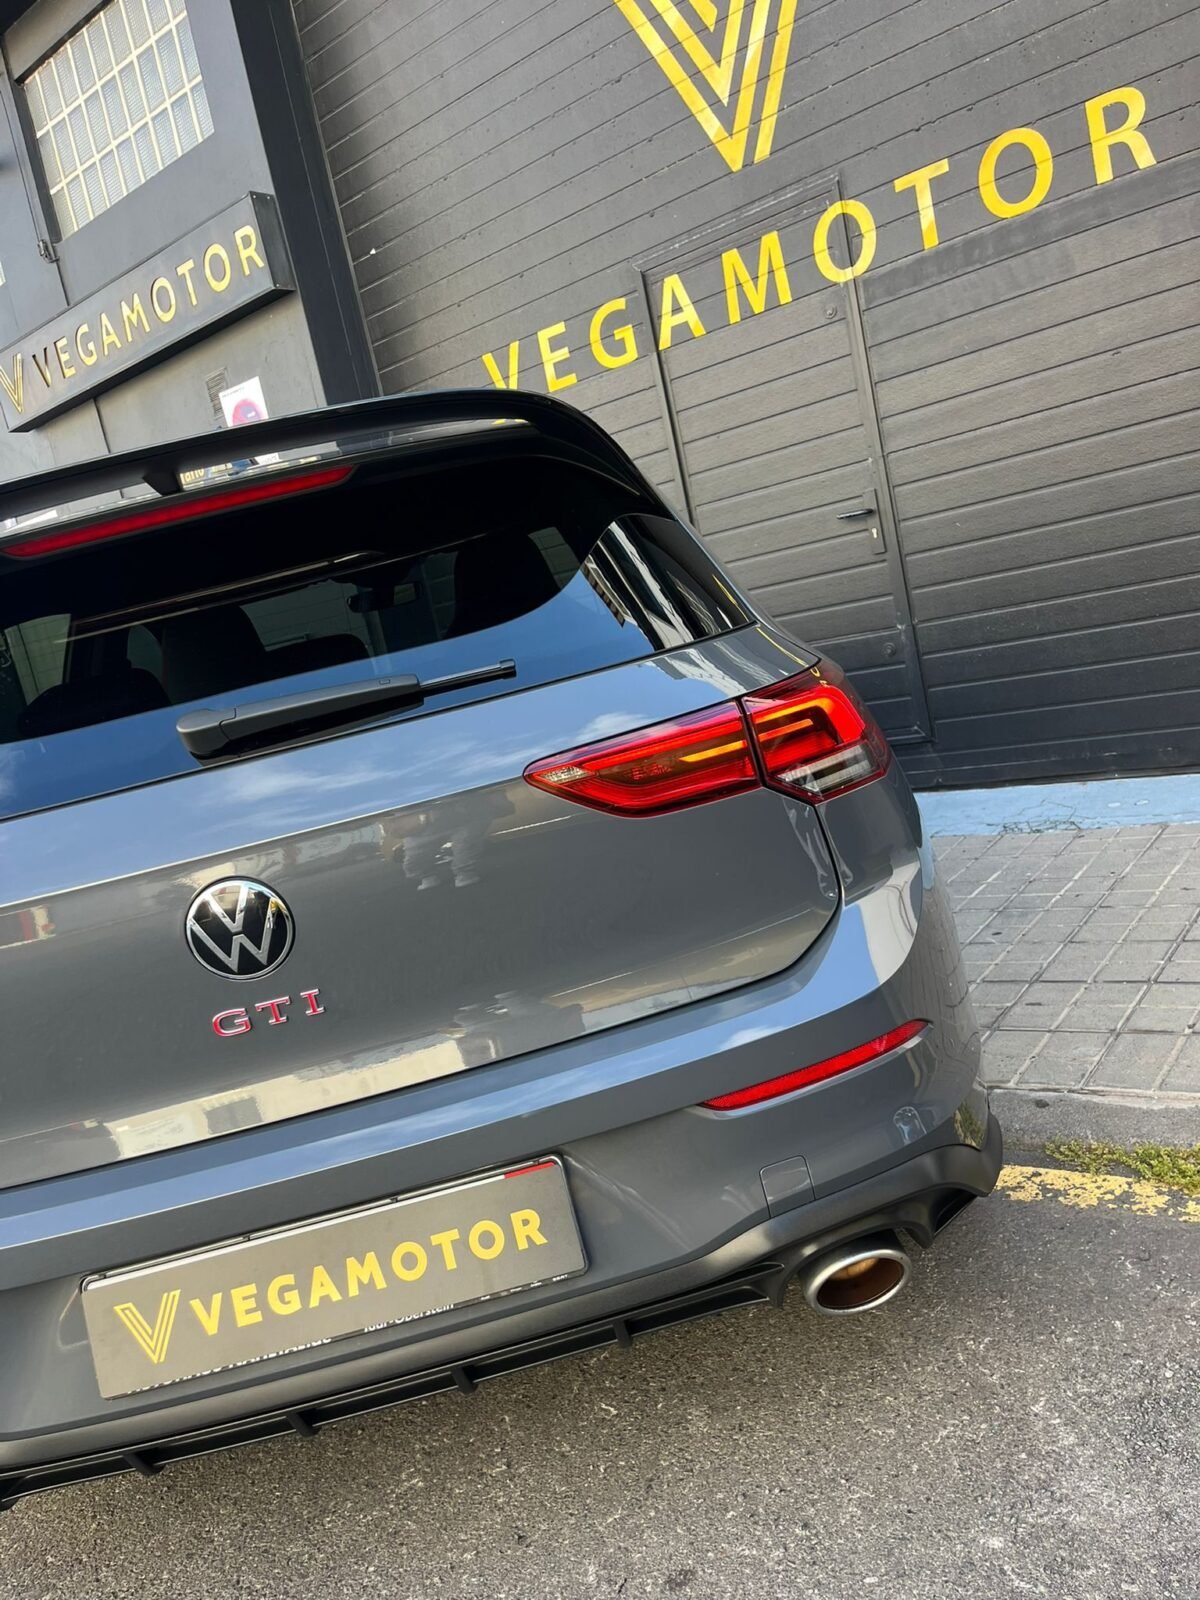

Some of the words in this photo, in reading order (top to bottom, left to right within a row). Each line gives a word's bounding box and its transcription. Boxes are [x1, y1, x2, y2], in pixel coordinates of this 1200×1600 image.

[32, 224, 265, 388] VEGAMOTOR
[480, 87, 1156, 394] VEGAMOTOR
[212, 988, 325, 1037] GTI
[189, 1208, 548, 1337] VEGAMOTOR
